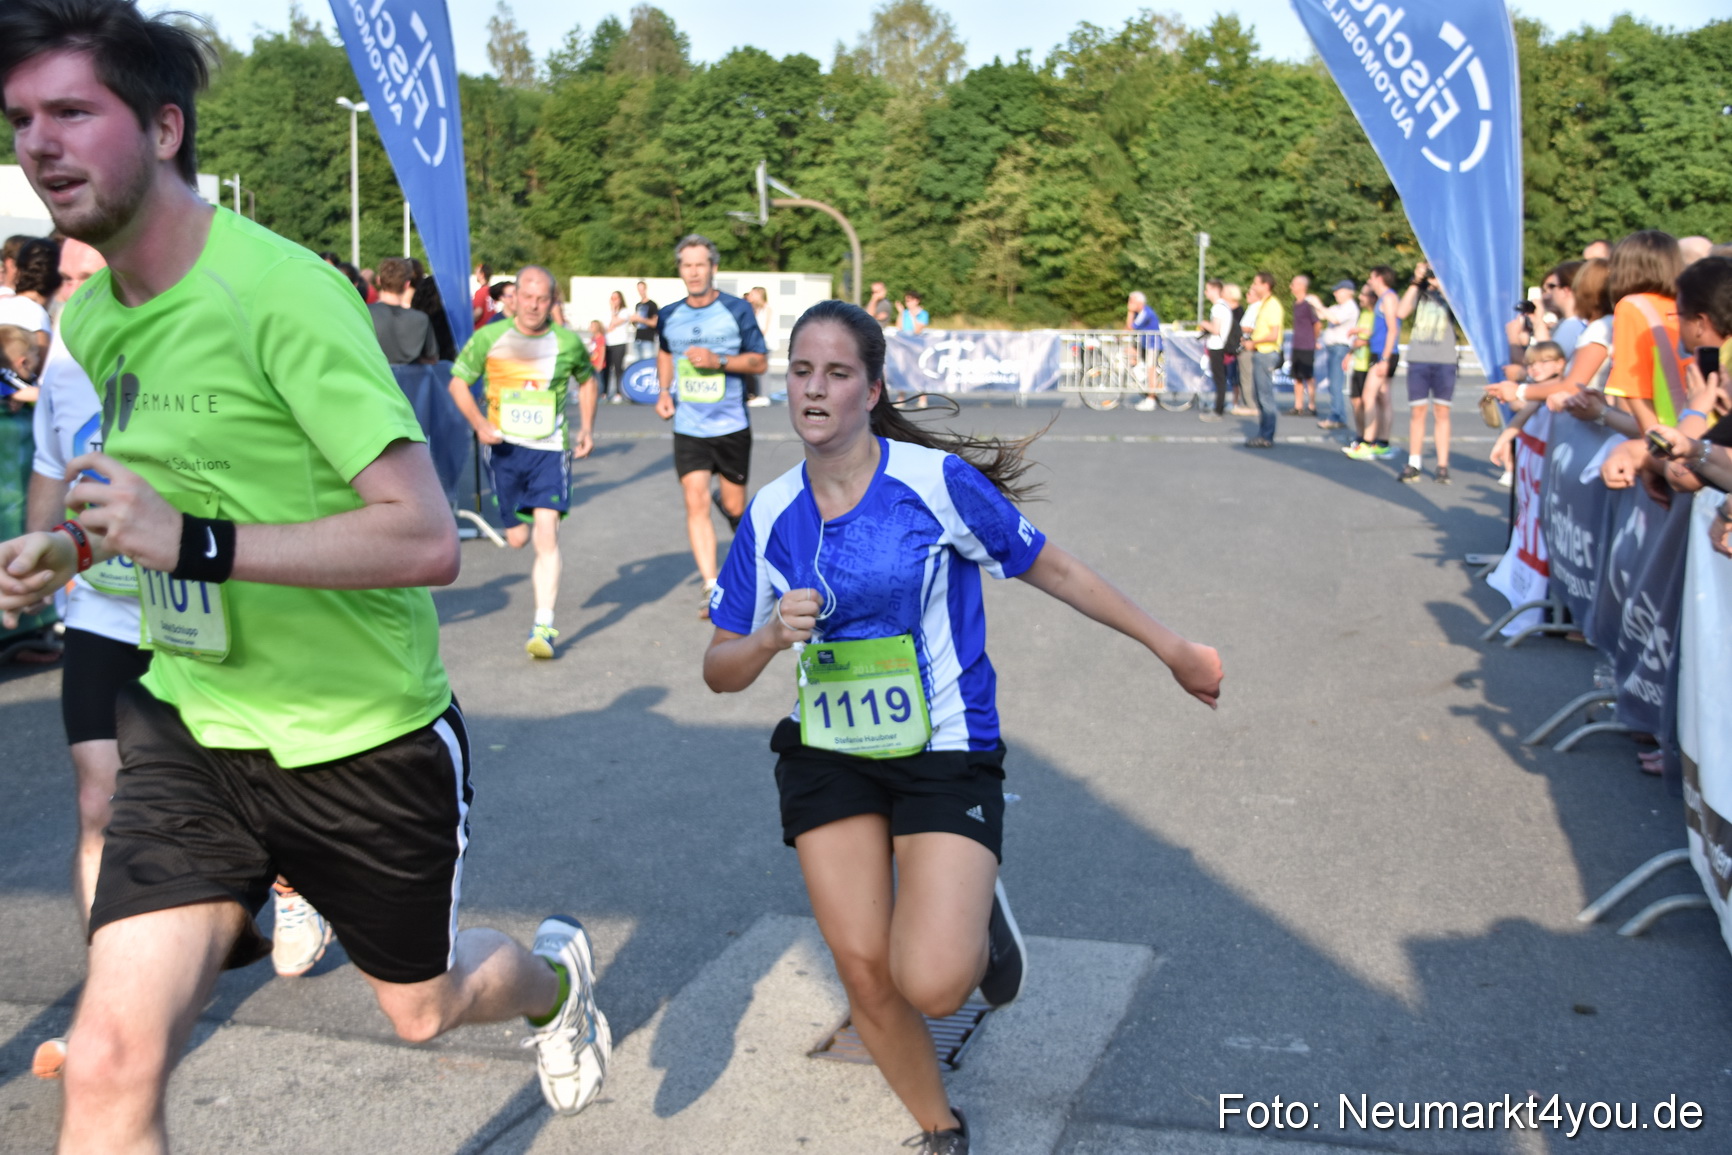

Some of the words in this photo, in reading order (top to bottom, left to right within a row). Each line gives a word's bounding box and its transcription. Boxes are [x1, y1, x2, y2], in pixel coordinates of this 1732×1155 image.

[511, 409, 543, 424] 996
[142, 565, 211, 614] 1101
[814, 685, 912, 729] 1119
[834, 735, 863, 745] Stefanie
